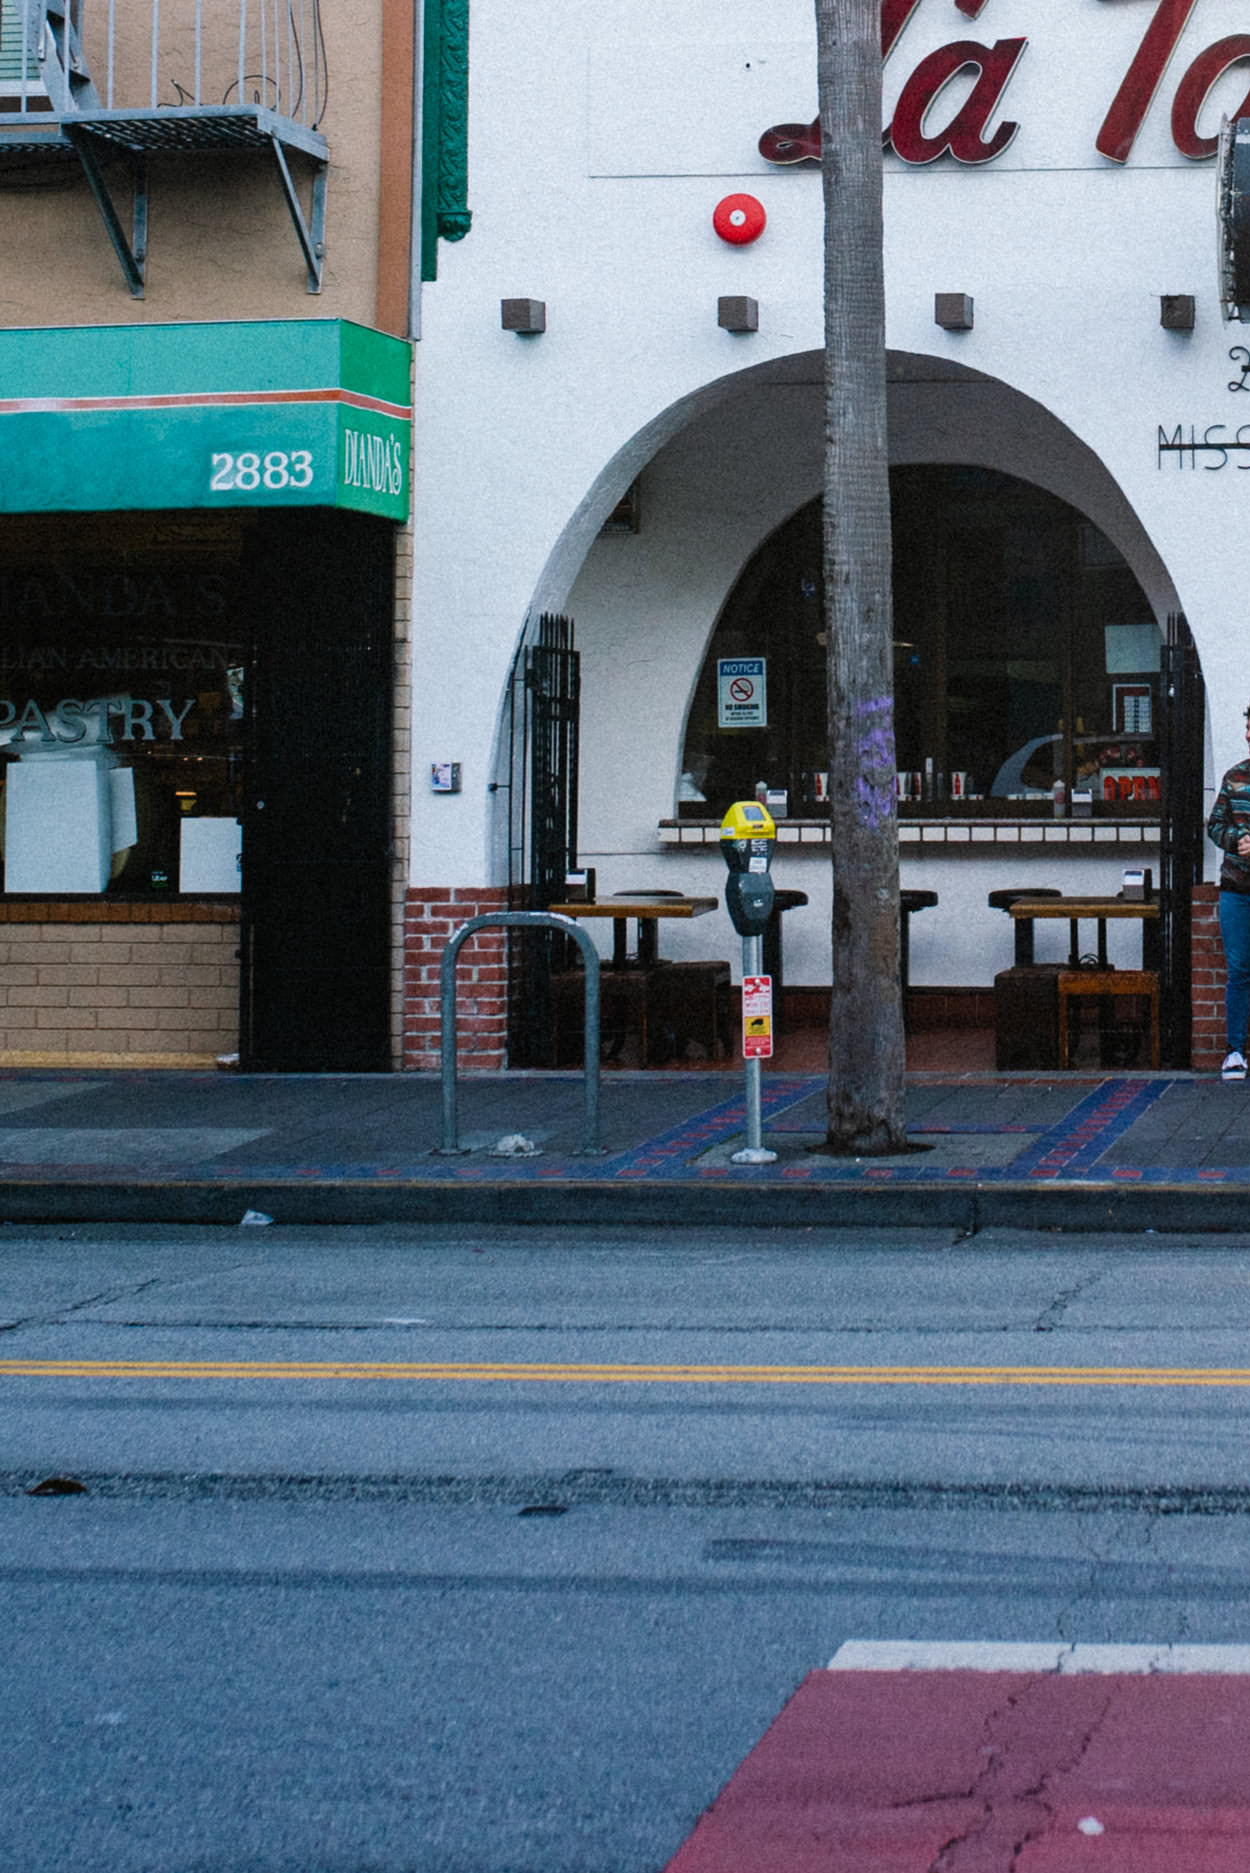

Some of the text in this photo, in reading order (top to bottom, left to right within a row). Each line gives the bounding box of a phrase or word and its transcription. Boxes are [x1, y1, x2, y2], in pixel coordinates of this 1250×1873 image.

[210, 450, 314, 491] 2883
[344, 429, 402, 495] DIANDA'S
[722, 663, 761, 674] NOTICE
